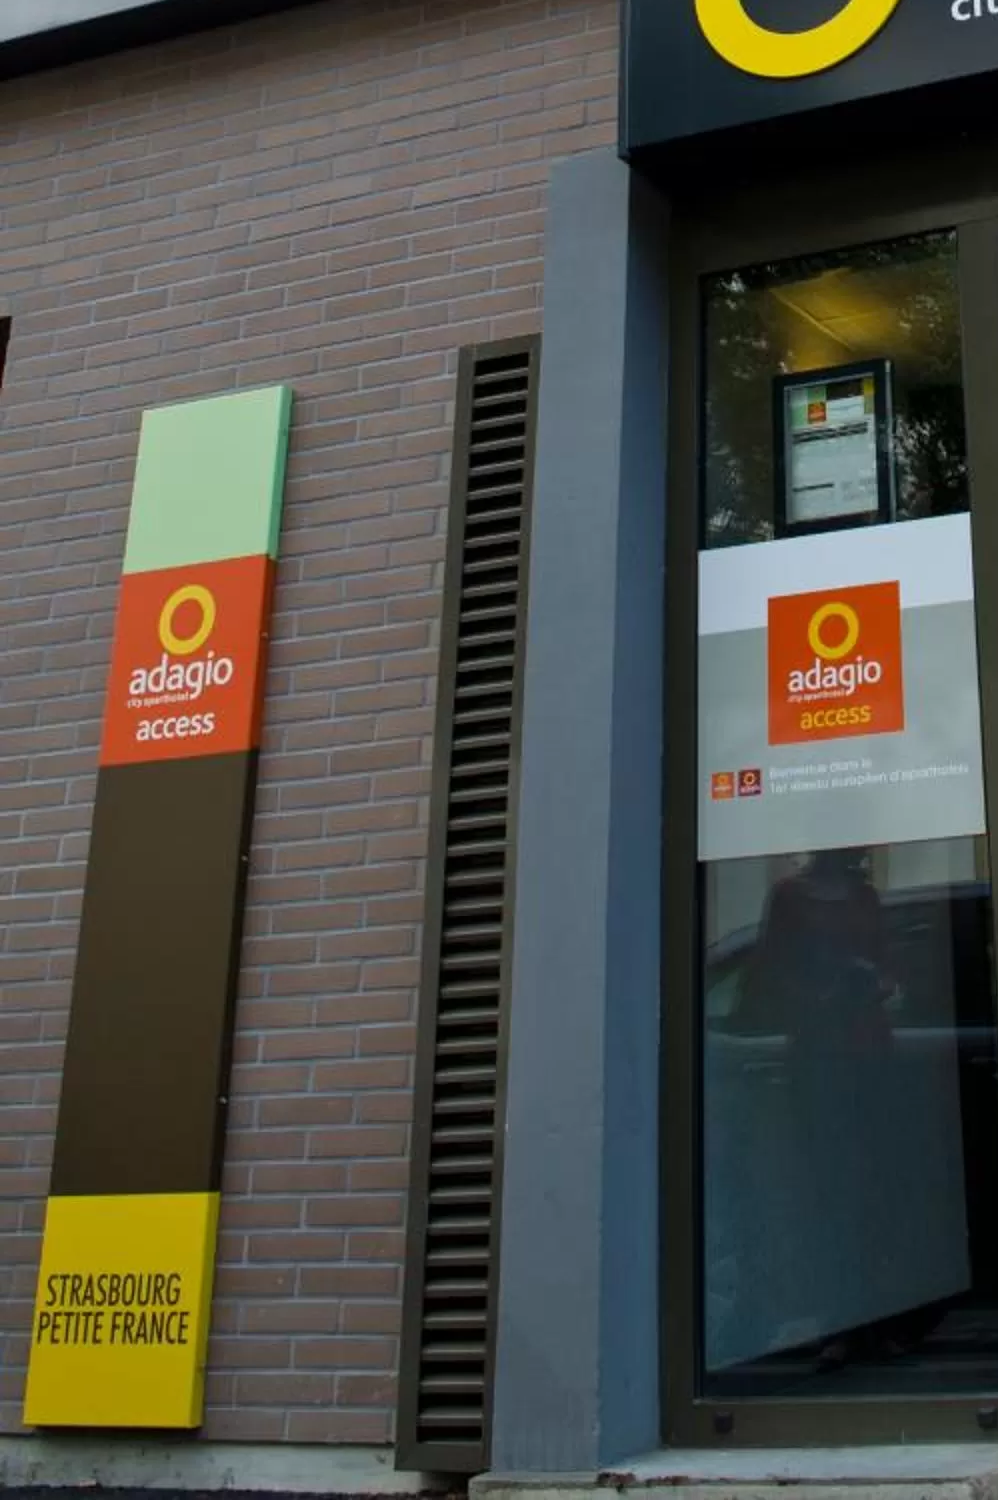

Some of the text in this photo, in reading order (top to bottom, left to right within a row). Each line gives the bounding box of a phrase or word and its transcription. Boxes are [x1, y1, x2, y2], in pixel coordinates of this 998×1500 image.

[129, 650, 234, 699] adagio
[787, 655, 882, 696] adagio
[136, 712, 215, 741] access
[800, 704, 872, 729] access
[45, 1273, 182, 1306] STRASBOURG
[37, 1311, 190, 1344] PETITE FRANCE
